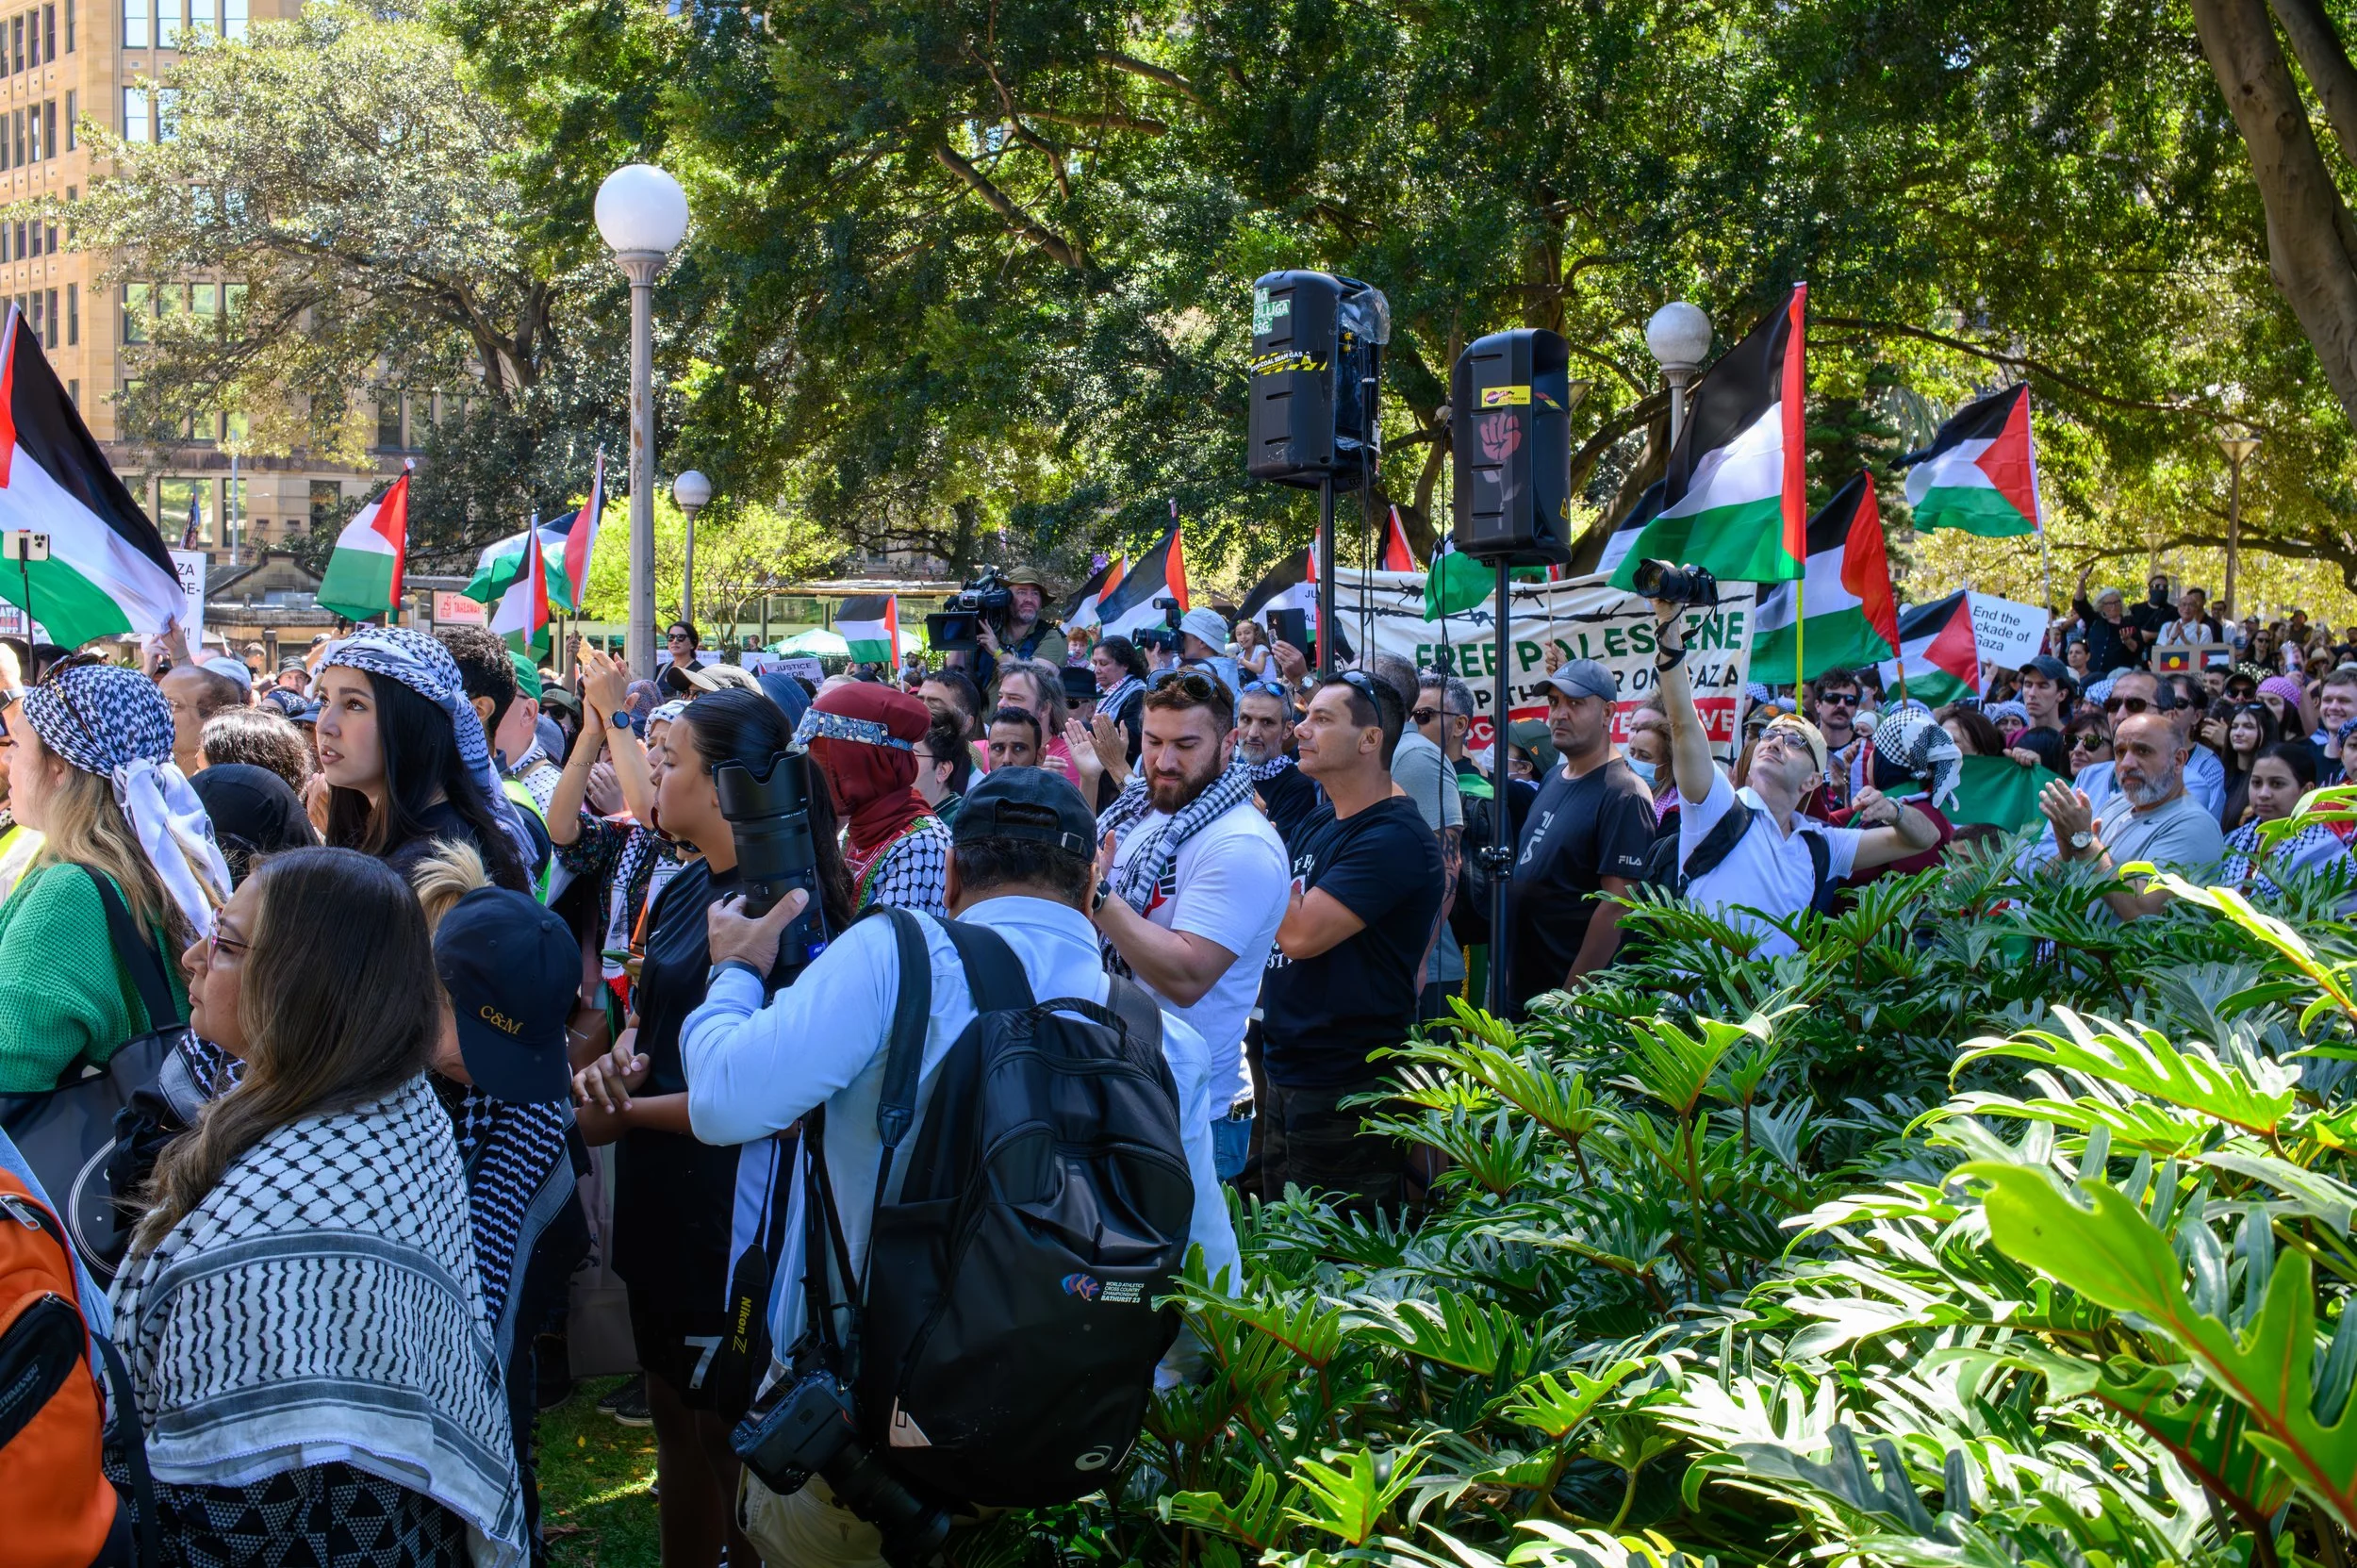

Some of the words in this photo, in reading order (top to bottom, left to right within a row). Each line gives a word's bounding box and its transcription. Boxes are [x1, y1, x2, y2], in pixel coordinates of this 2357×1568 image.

[1255, 290, 1267, 304] NO
[1253, 302, 1289, 318] PILLIGA
[1260, 358, 1274, 367] COAL
[1275, 354, 1289, 362] SEAM
[1973, 605, 1999, 621] End
[2001, 613, 2020, 626] the
[1416, 643, 1496, 678] FREE
[1516, 611, 1744, 672] PLESINE
[2017, 632, 2032, 643] of
[775, 662, 812, 672] JUSTICE
[1520, 810, 1555, 865] FILA
[1618, 854, 1643, 866] FILA
[480, 1005, 524, 1034] C&M
[737, 1296, 751, 1334] Nikon
[733, 1335, 747, 1354] Z
[684, 1336, 723, 1389] 7
